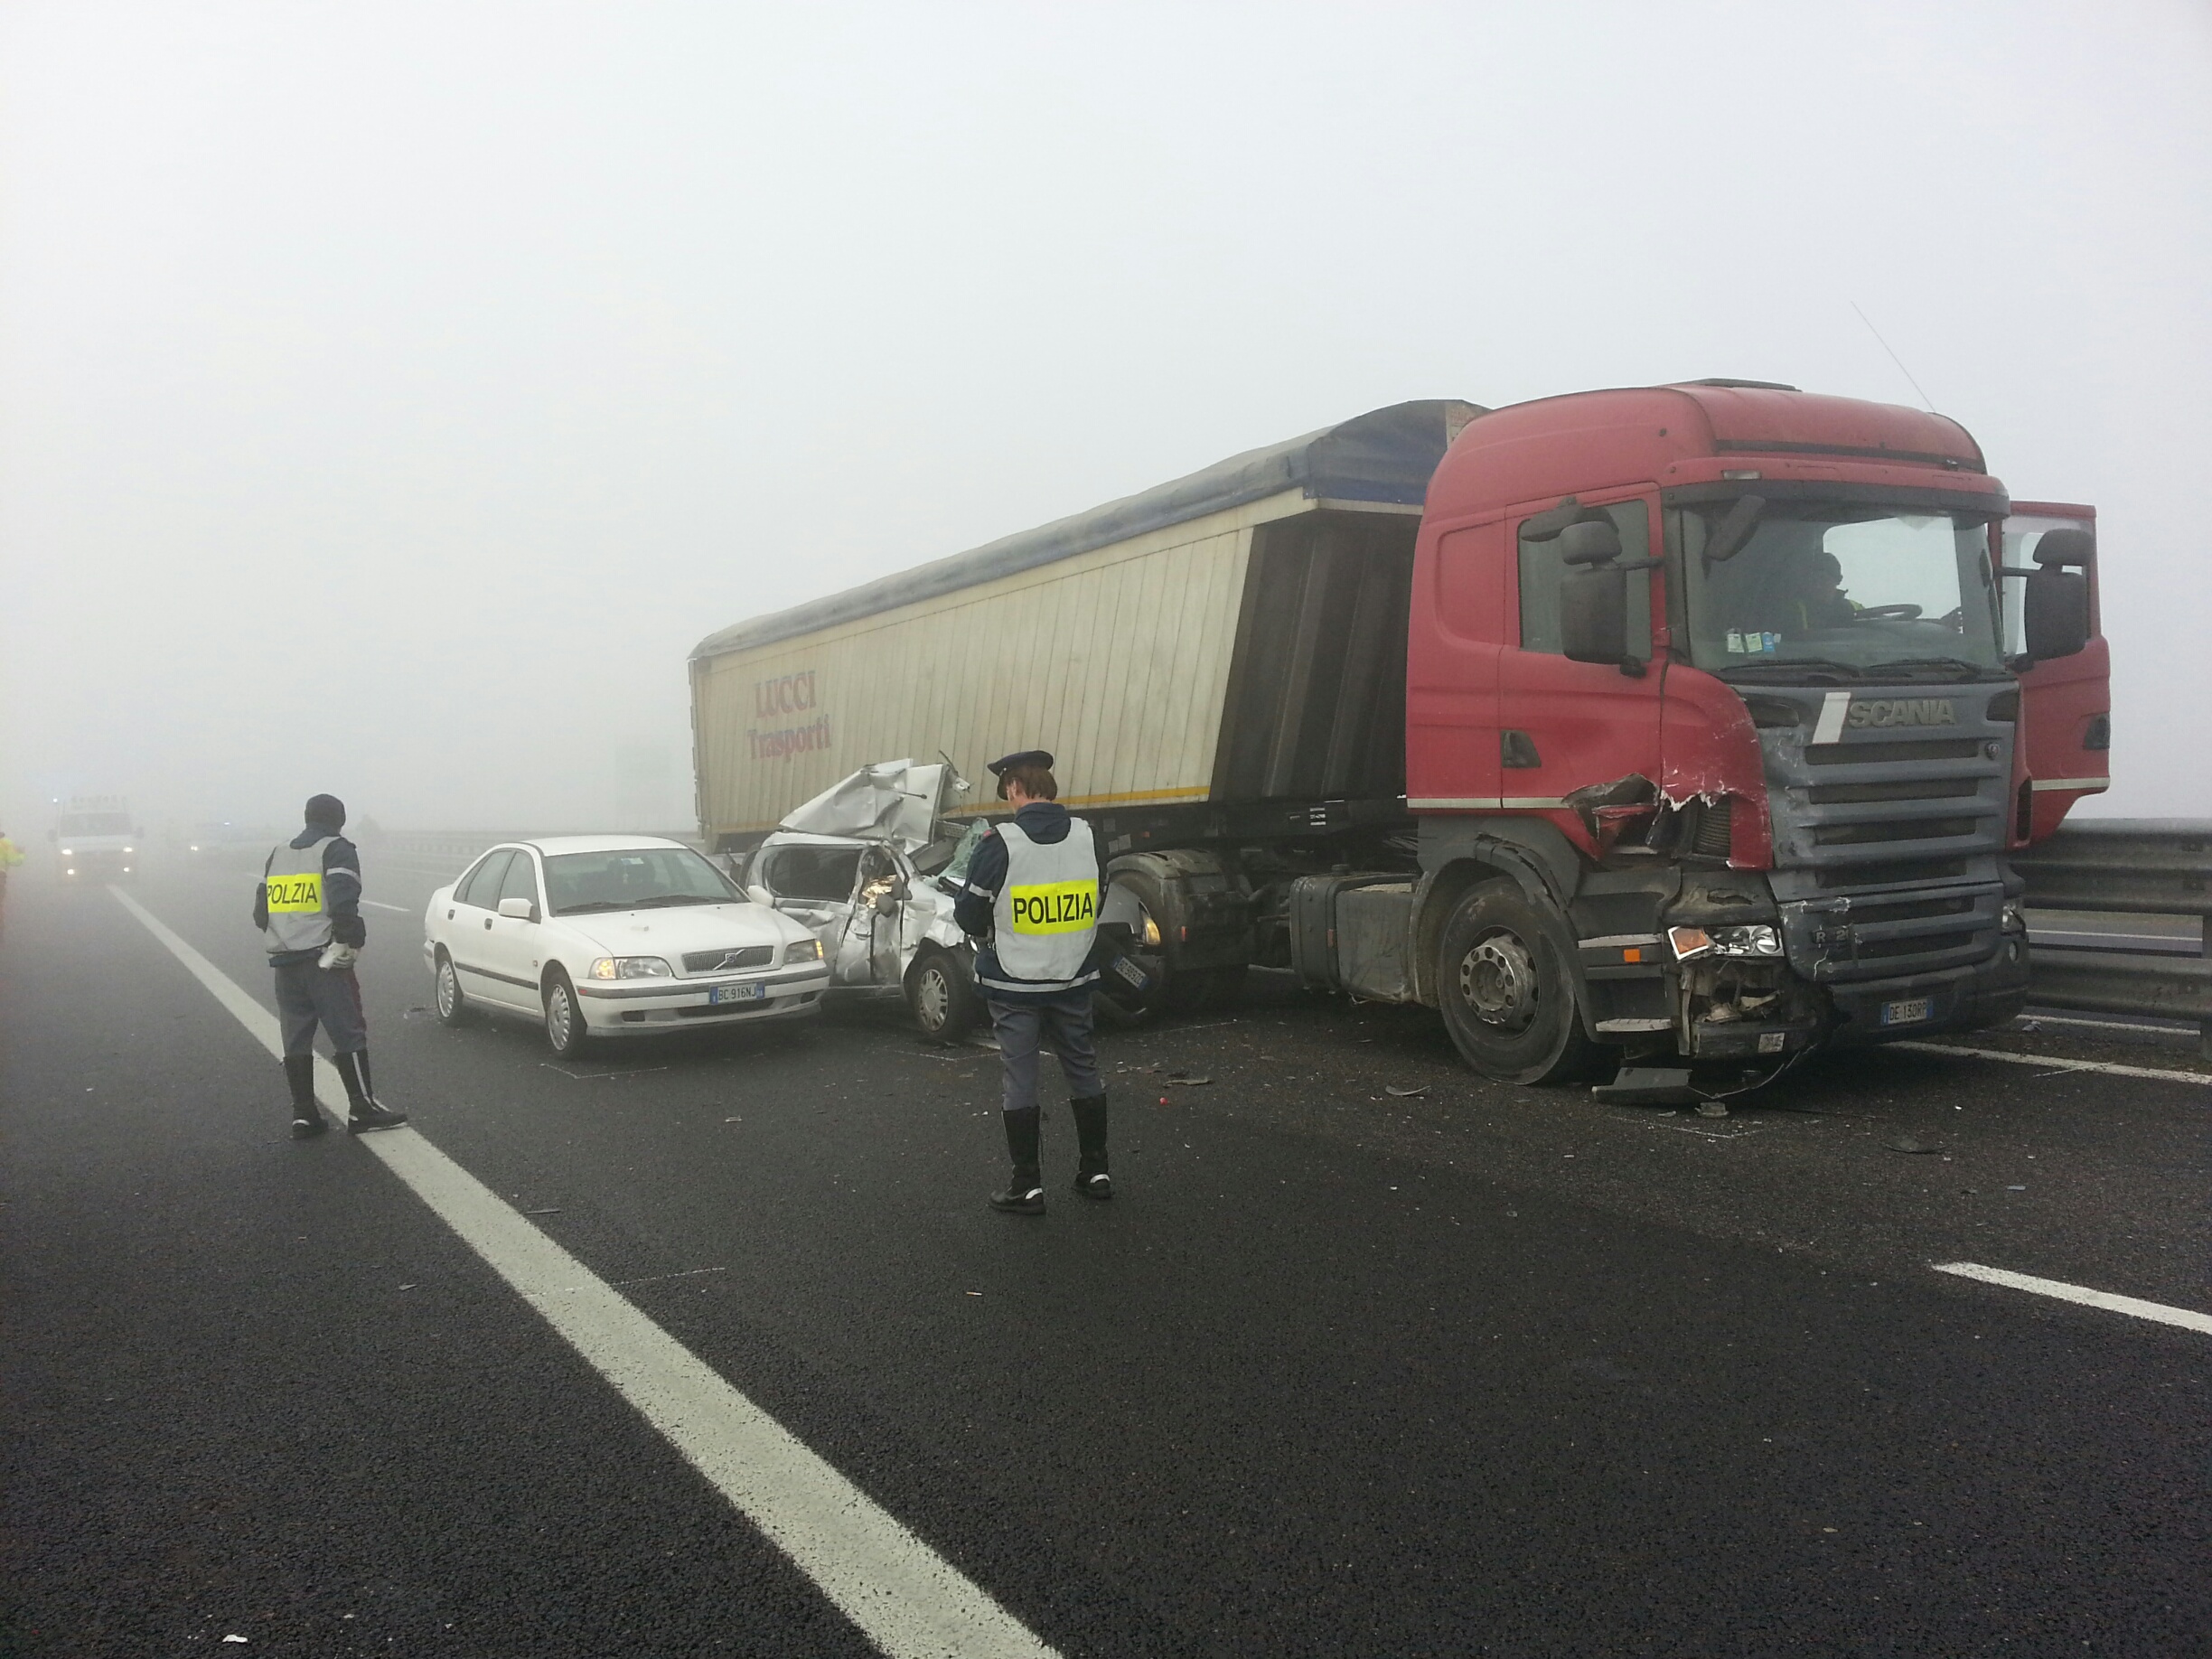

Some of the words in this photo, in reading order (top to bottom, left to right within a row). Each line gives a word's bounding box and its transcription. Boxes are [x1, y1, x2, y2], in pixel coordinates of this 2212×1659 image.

[755, 670, 817, 718] LUCCI
[1849, 700, 1956, 727] SCANIA
[747, 713, 831, 764] Trasporti
[1013, 892, 1092, 924] POLIZIA
[718, 989, 728, 1001] BC
[731, 986, 756, 999] 916NJ
[1889, 1006, 1899, 1020] DE
